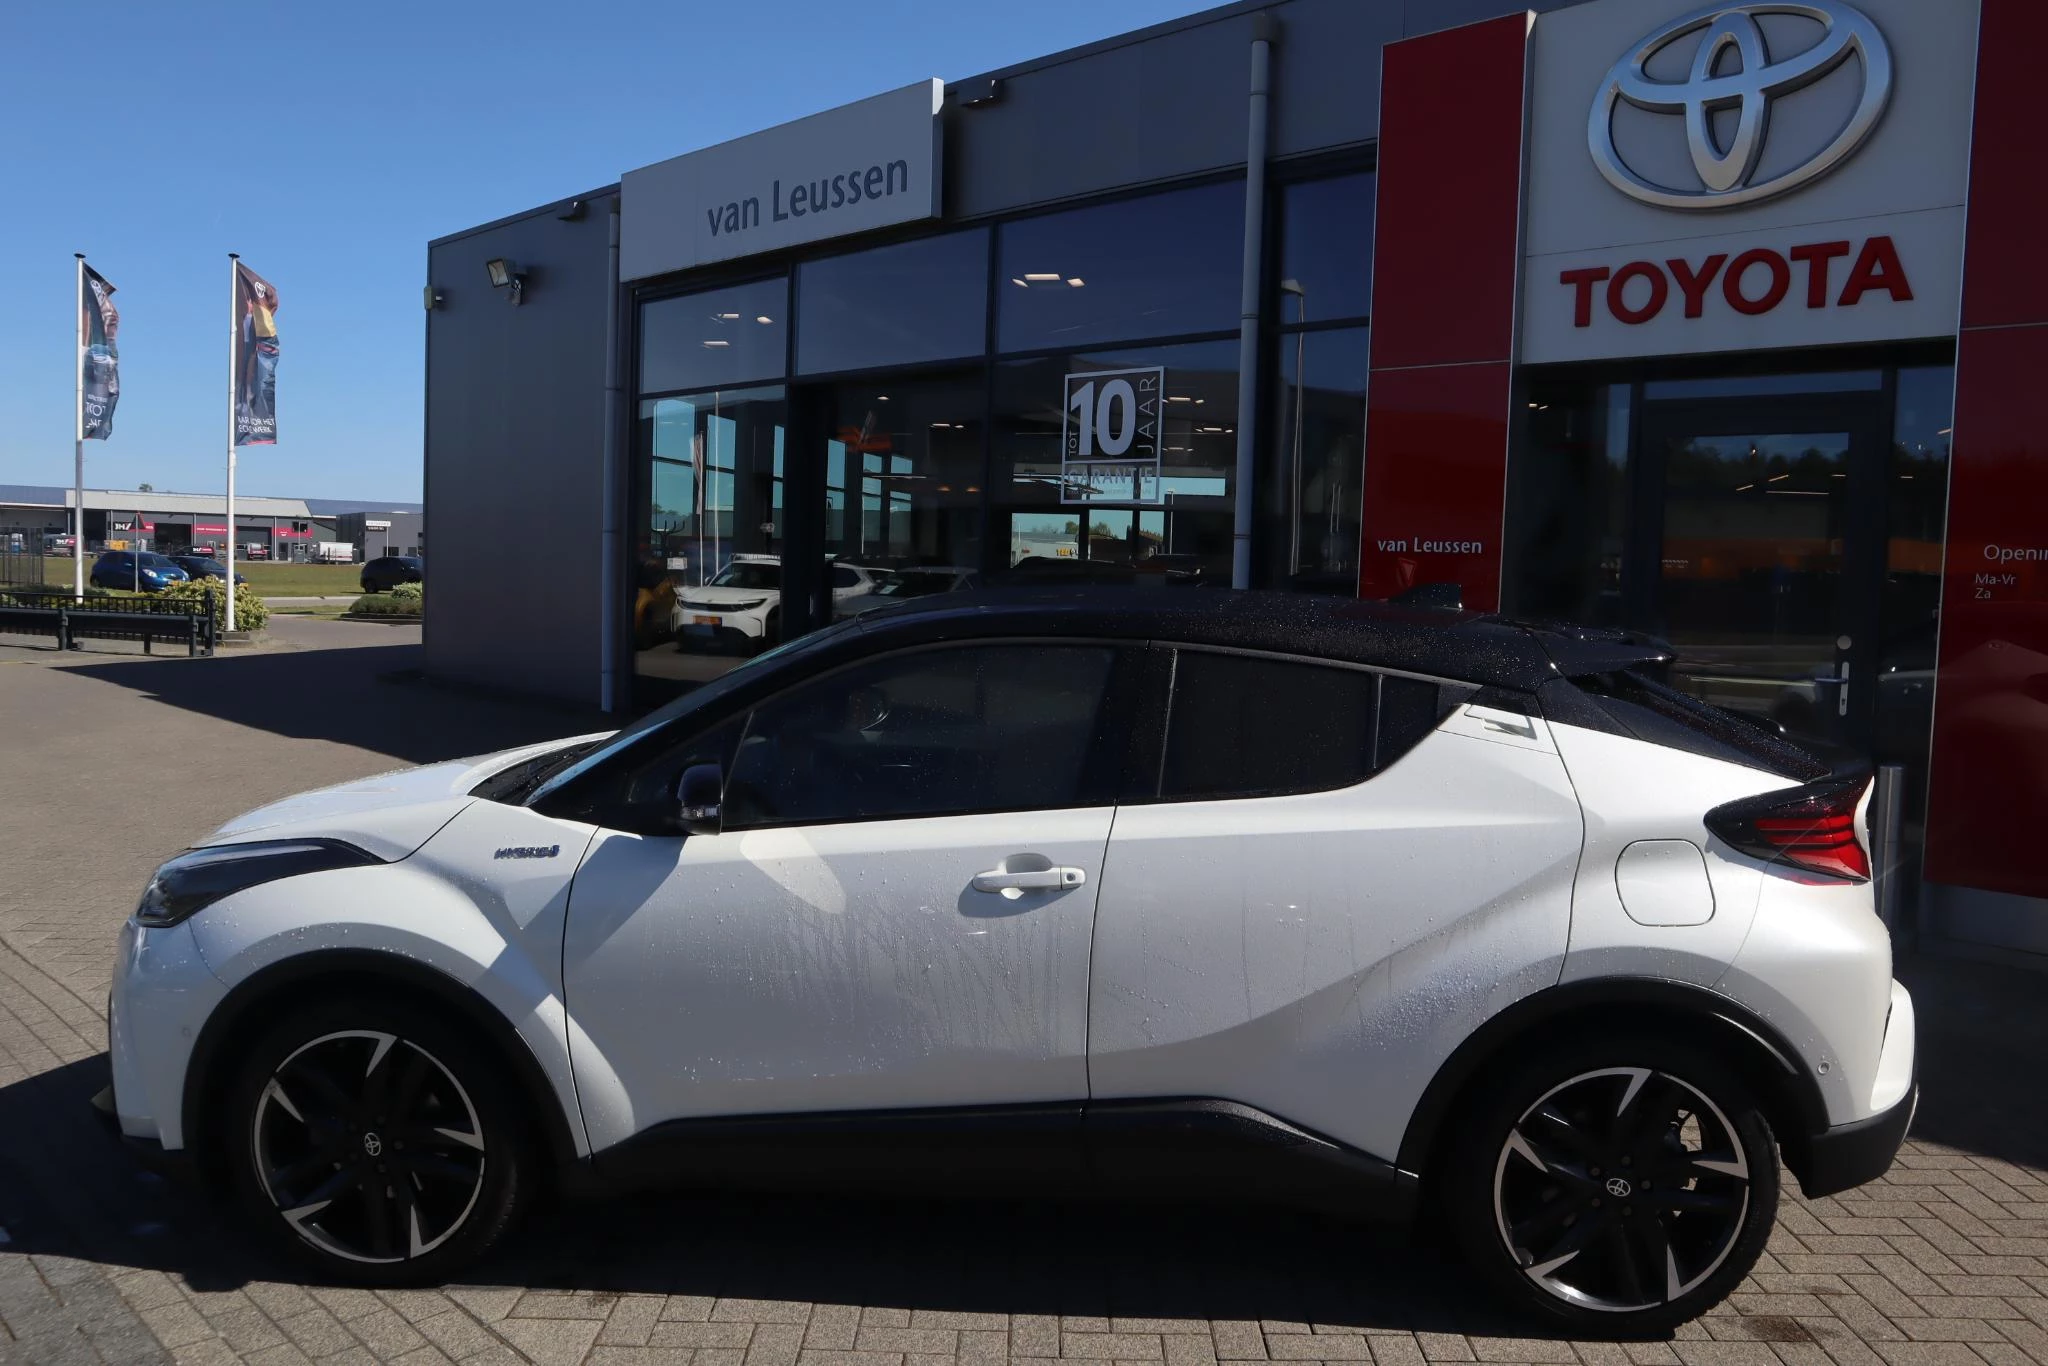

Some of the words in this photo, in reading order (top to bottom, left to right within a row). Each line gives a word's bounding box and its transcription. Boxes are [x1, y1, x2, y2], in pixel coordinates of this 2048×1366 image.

[707, 197, 760, 237] van
[772, 159, 908, 223] Leussen
[1559, 235, 1914, 328] TOYOTA
[1070, 378, 1136, 456] 10
[1137, 377, 1156, 454] JAAR
[1068, 429, 1078, 457] TOT
[1068, 467, 1153, 484] GARANTIE
[1377, 540, 1407, 553] van
[1413, 536, 1483, 554] Leussen
[1974, 572, 2017, 585] Ma-Vr
[1974, 587, 1992, 600] Za
